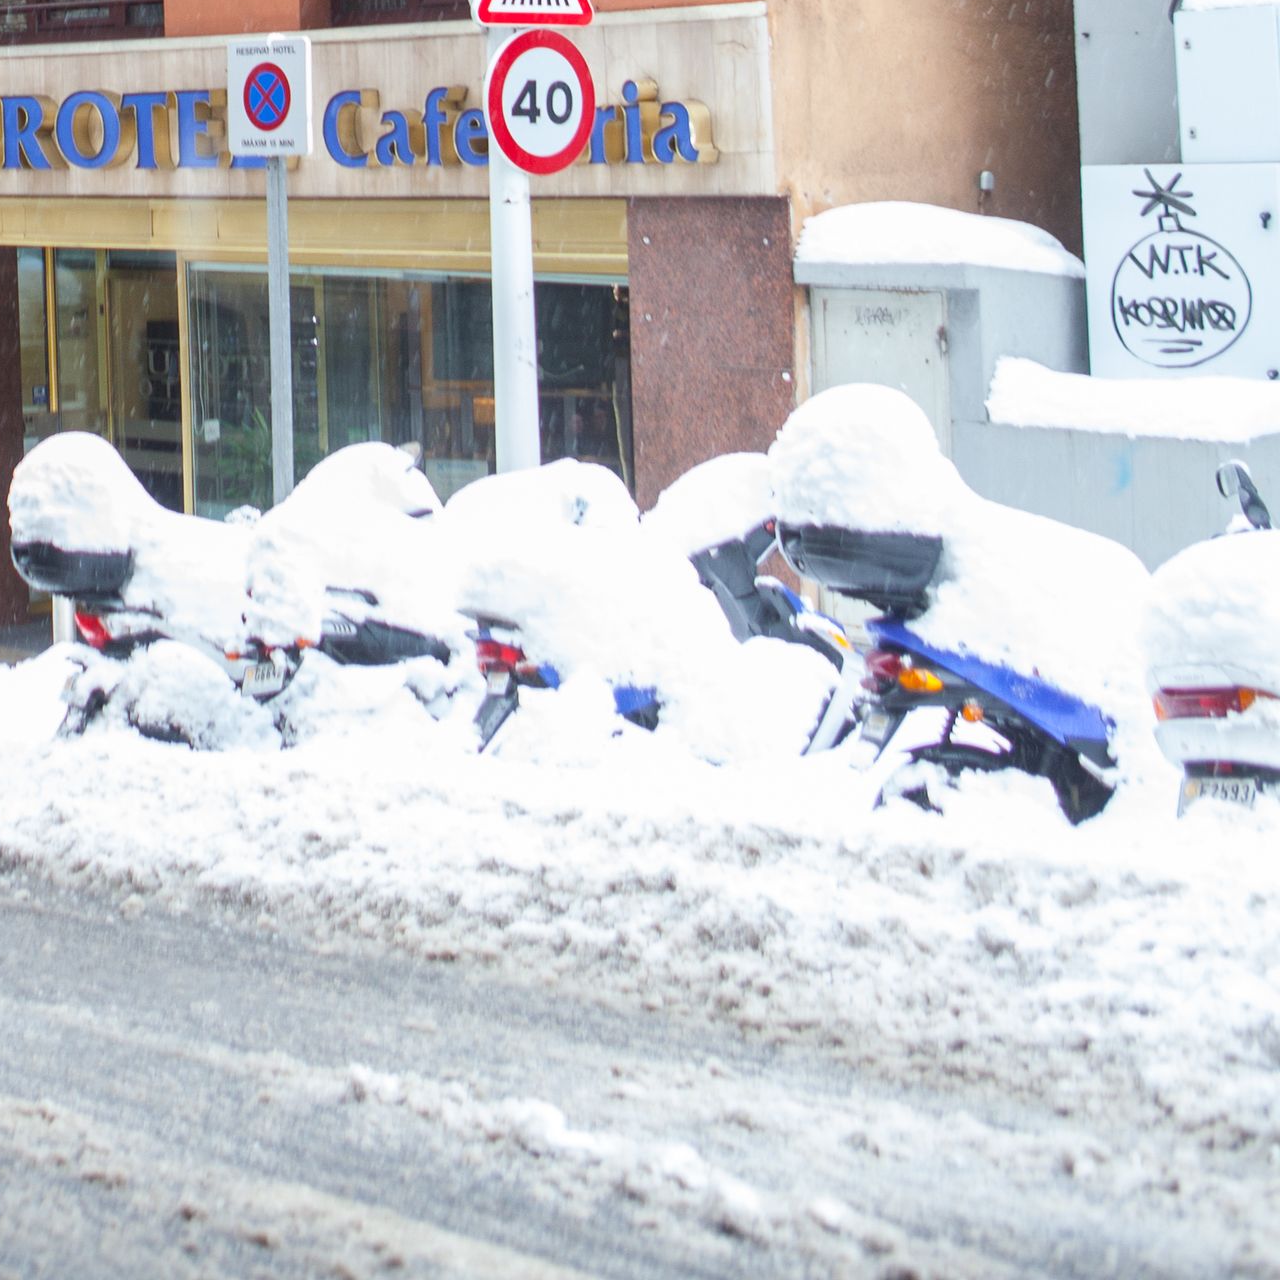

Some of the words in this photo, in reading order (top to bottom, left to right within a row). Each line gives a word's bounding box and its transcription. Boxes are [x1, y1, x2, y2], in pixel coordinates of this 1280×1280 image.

[236, 46, 269, 56] RESERVAT
[273, 45, 296, 55] HOTEL
[322, 79, 702, 168] Caferia
[511, 79, 573, 125] 40
